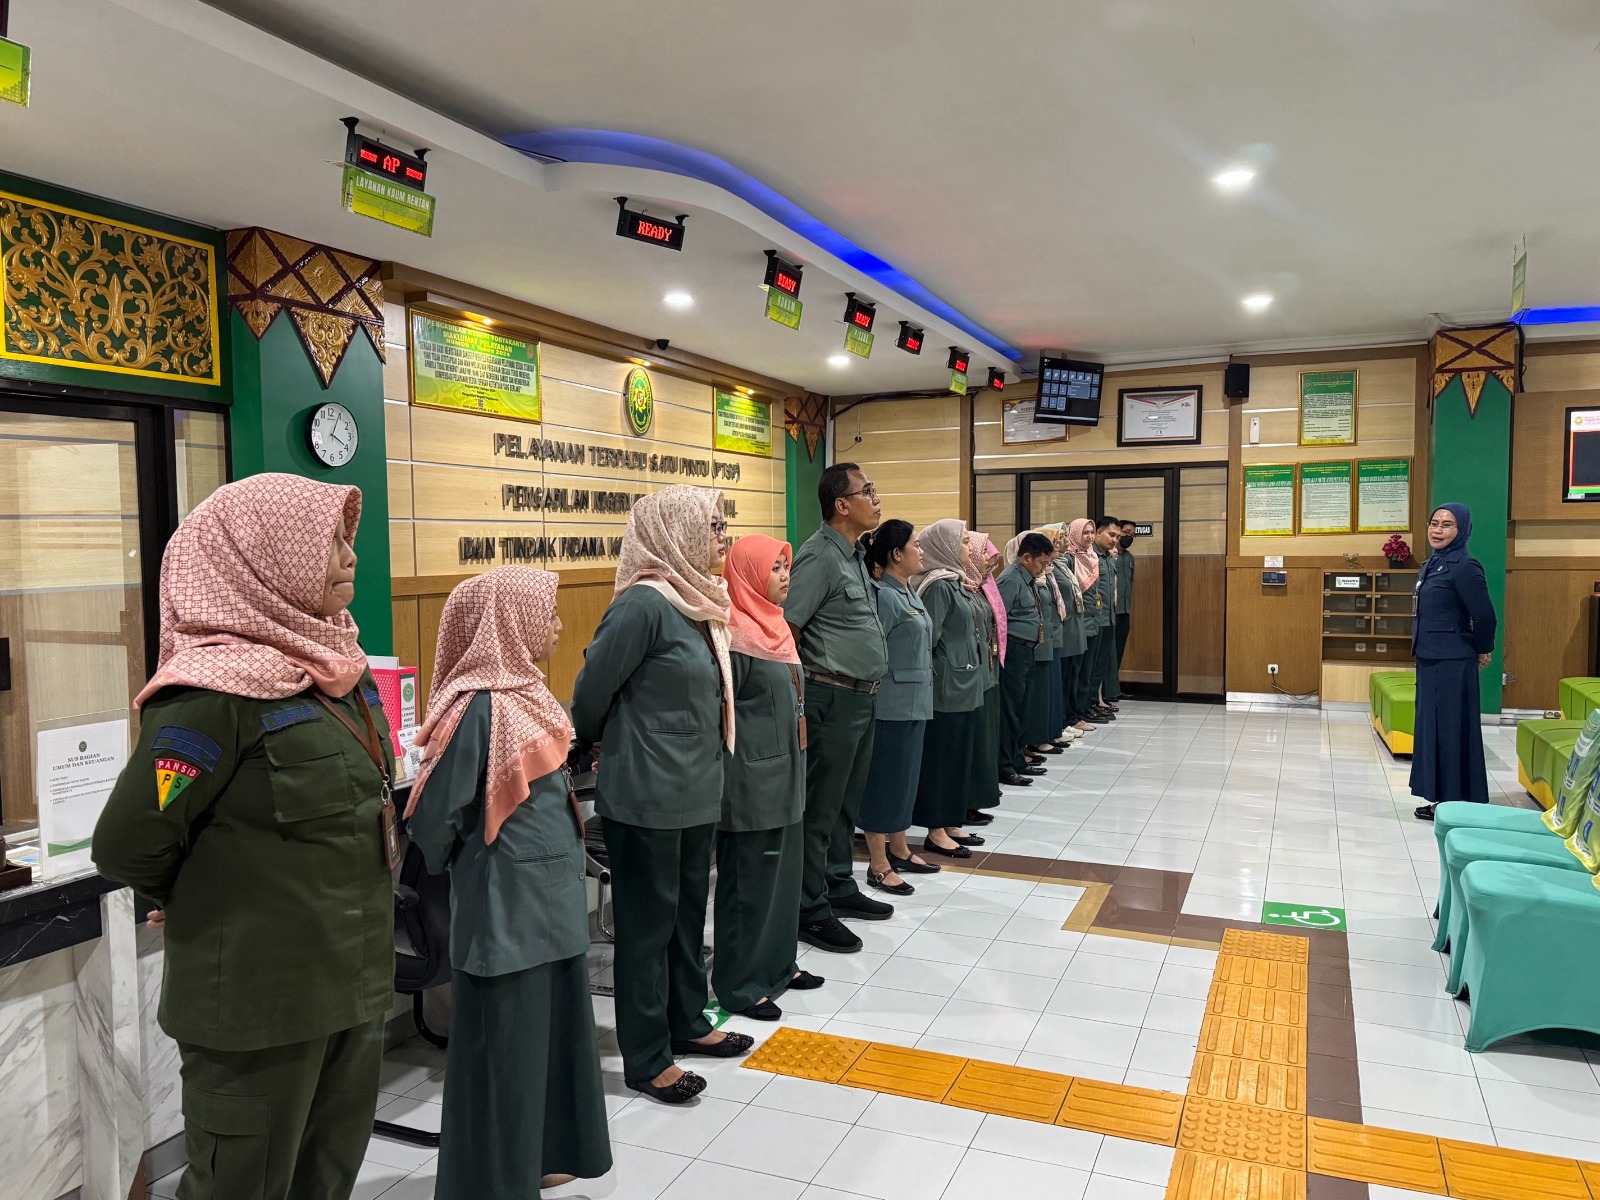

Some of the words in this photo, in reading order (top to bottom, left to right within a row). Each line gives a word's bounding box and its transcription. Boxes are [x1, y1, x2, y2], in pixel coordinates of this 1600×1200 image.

[382, 155, 400, 173] AP
[356, 175, 386, 196] LAYANAN
[387, 186, 406, 202] KAUM
[407, 193, 431, 211] RENTAN
[637, 220, 672, 241] READY
[426, 319, 467, 334] PENGADILAN
[491, 333, 527, 349] YOGYAKARTA
[442, 330, 478, 344] MAKLUMAT
[479, 337, 513, 353] PELAYANAN
[321, 410, 326, 419] 11
[328, 408, 335, 417] 12
[344, 422, 348, 430] 2
[348, 433, 351, 441] 3
[315, 441, 319, 449] 8
[344, 444, 348, 452] 4
[322, 450, 326, 458] 7
[339, 451, 343, 459] 5
[494, 432, 586, 465] PELAYANAN
[588, 446, 648, 471] TERPADU
[649, 453, 679, 474] SATU
[502, 484, 590, 513] PENGADILAN
[1134, 526, 1151, 534] ETUGAS
[459, 536, 496, 565] DAN
[498, 536, 558, 563] TINDAK
[79, 752, 101, 761] BAGIAN
[84, 755, 115, 766] KEUANGAN
[158, 760, 197, 777] PANSID
[162, 773, 171, 786] P
[174, 776, 183, 789] S
